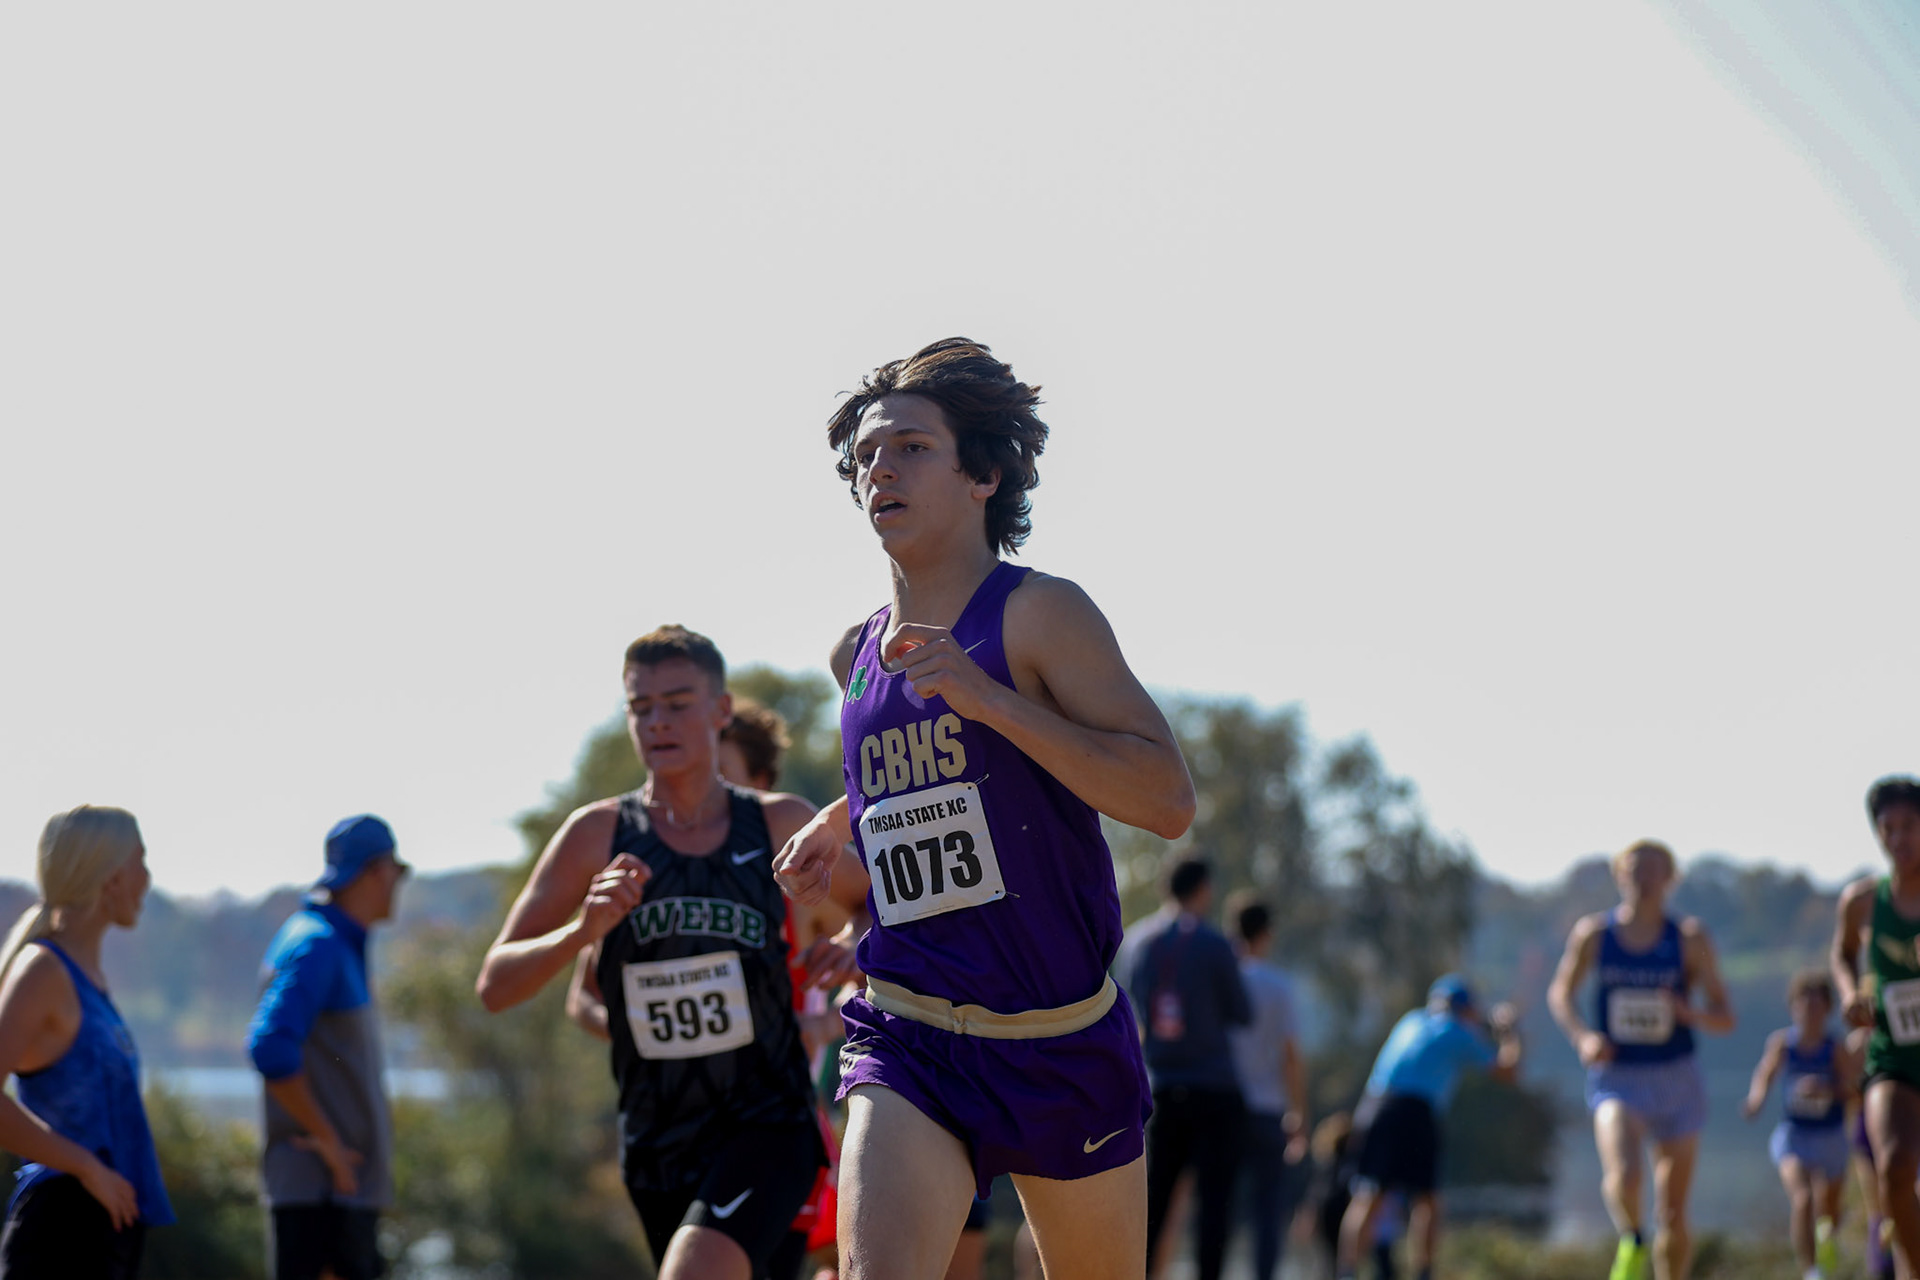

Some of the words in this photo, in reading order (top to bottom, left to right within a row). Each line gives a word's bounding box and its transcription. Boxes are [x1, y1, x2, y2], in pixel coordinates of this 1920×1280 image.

[861, 714, 967, 797] CBHS
[868, 812, 904, 834] TMSAA
[905, 804, 946, 827] STATE
[948, 797, 968, 817] XC
[874, 830, 983, 905] 1073
[629, 897, 767, 948] WEBB
[647, 992, 730, 1042] 593
